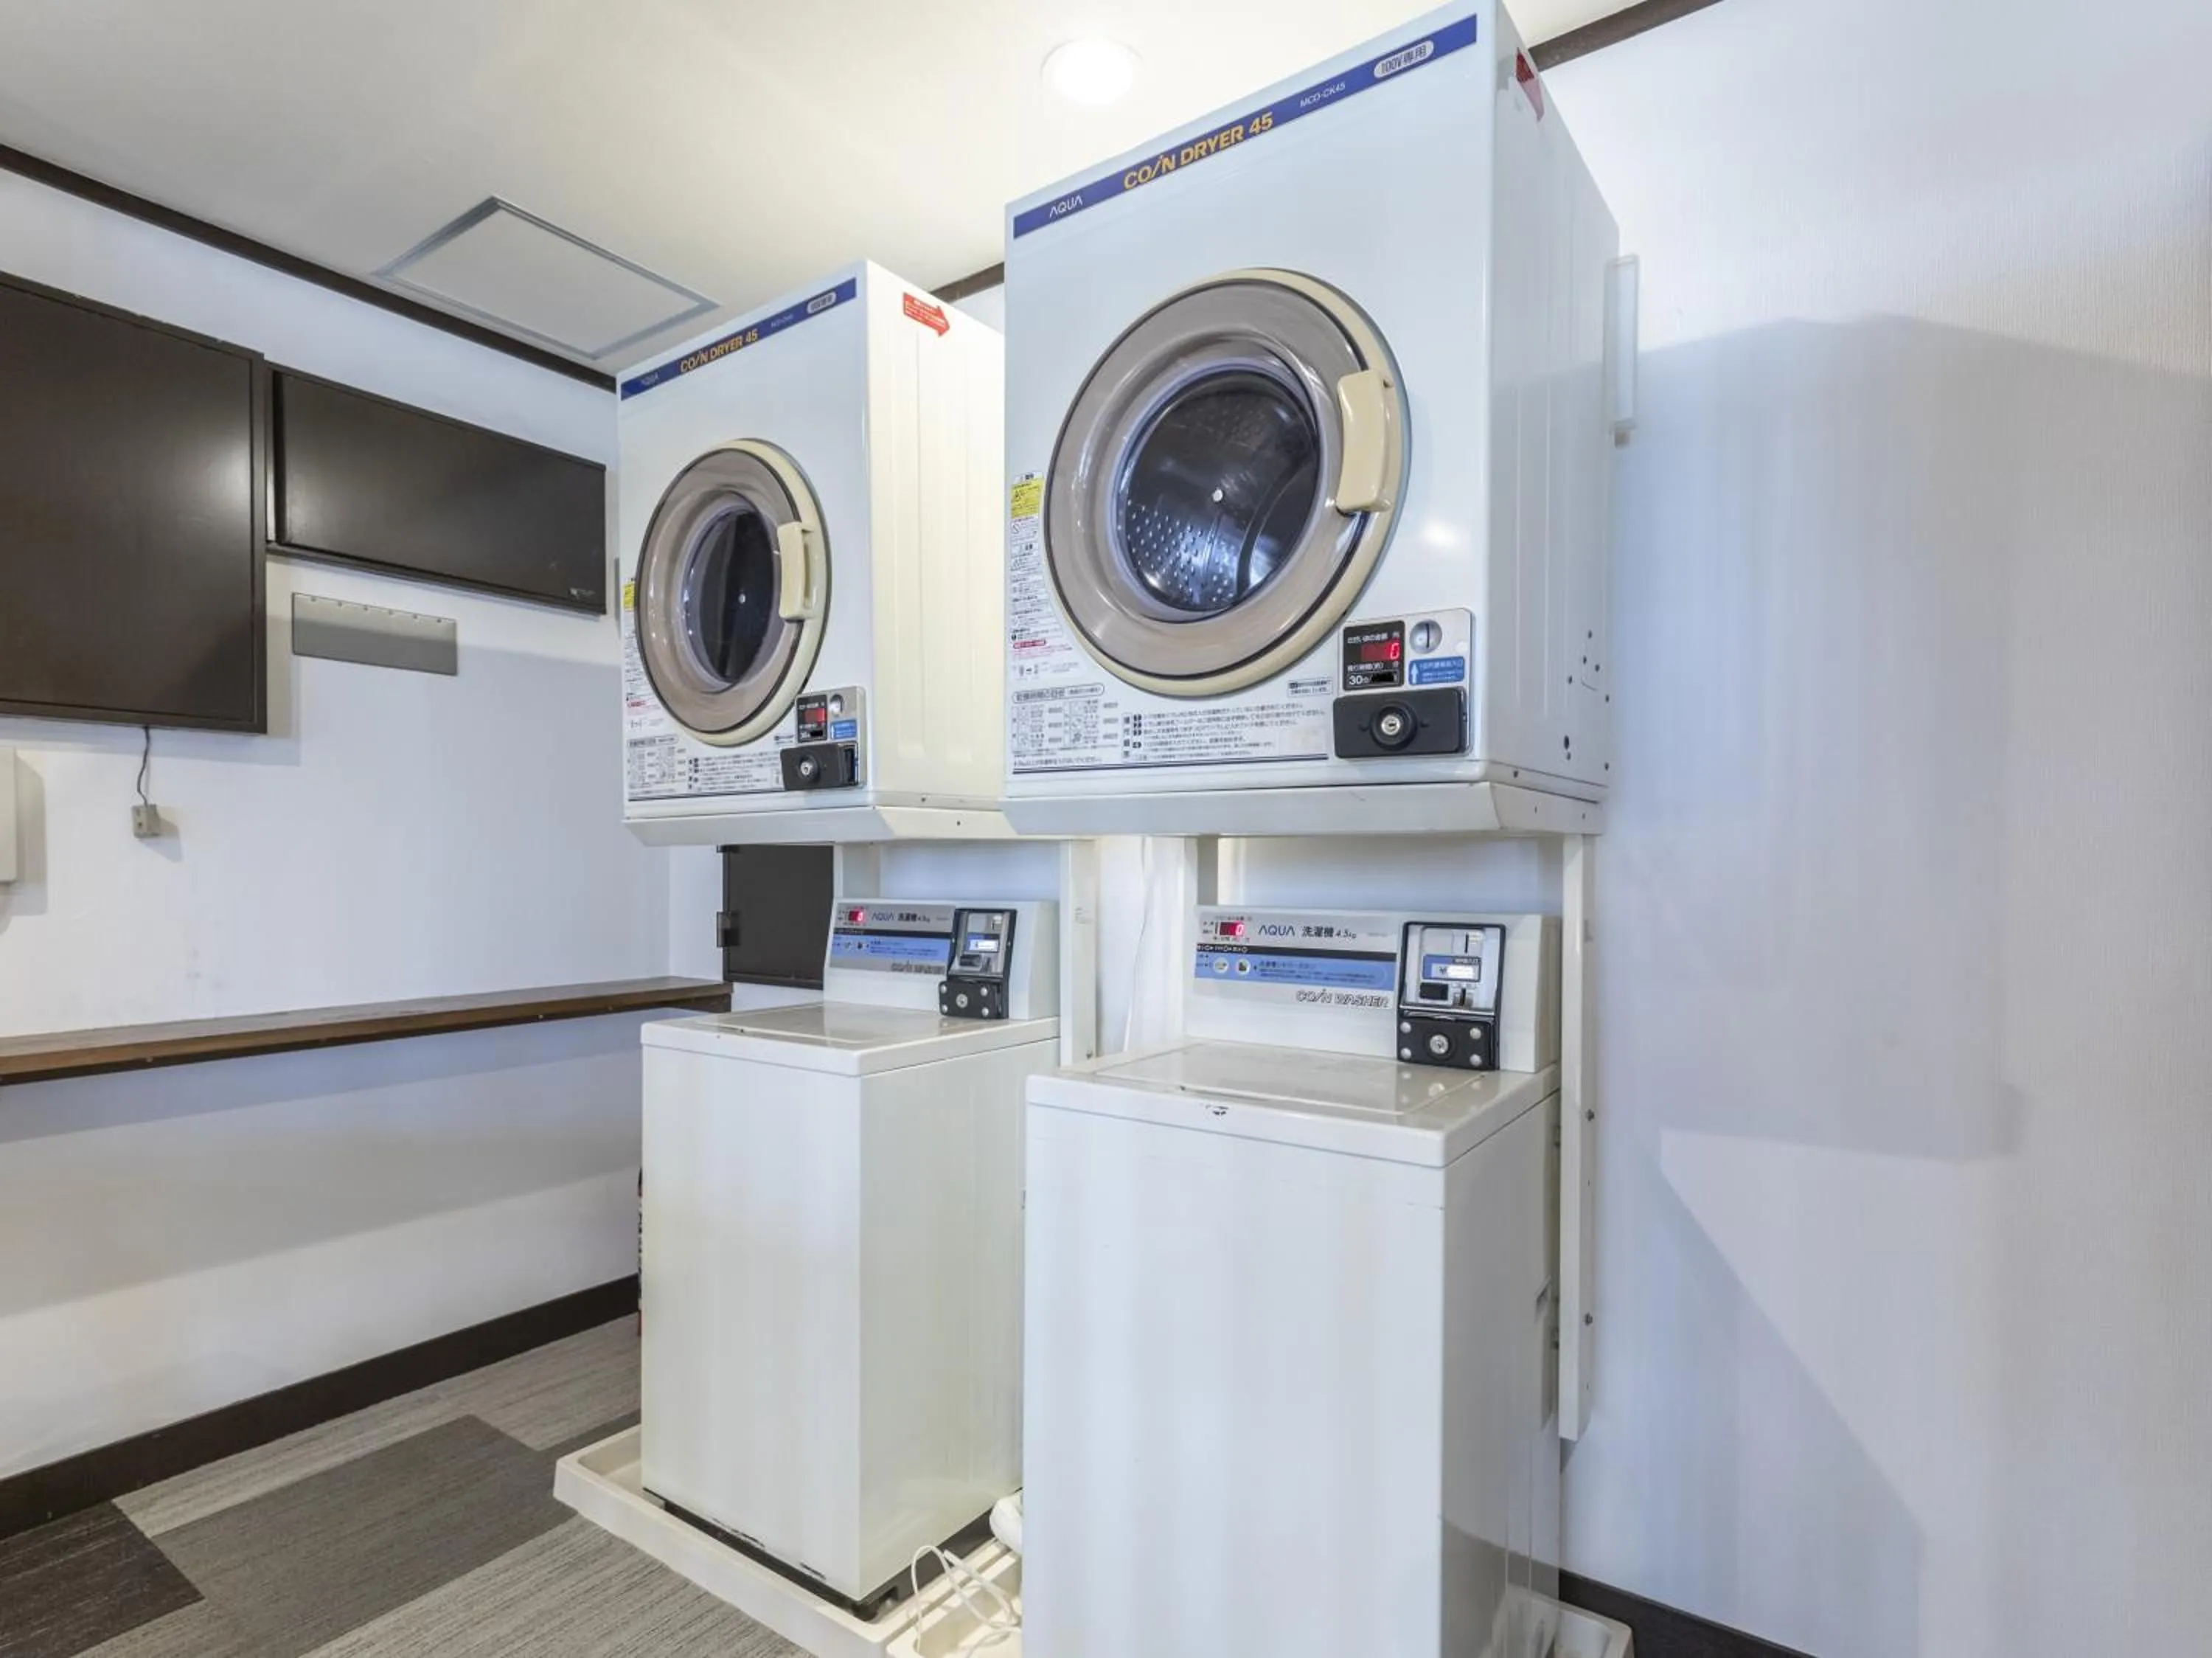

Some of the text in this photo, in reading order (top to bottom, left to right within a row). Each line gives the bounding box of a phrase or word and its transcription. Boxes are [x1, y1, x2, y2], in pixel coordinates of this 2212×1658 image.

[1048, 194, 1084, 219] AQUA
[1180, 125, 1245, 166] DRYER
[1249, 111, 1274, 136] 45
[710, 336, 743, 358] DRYER
[745, 328, 758, 342] 45
[1389, 642, 1399, 660] 0
[1235, 923, 1245, 936] 0
[1258, 924, 1295, 937] AQUA
[1302, 926, 1335, 937] 洗濯機
[1334, 993, 1389, 1008] WASHER
